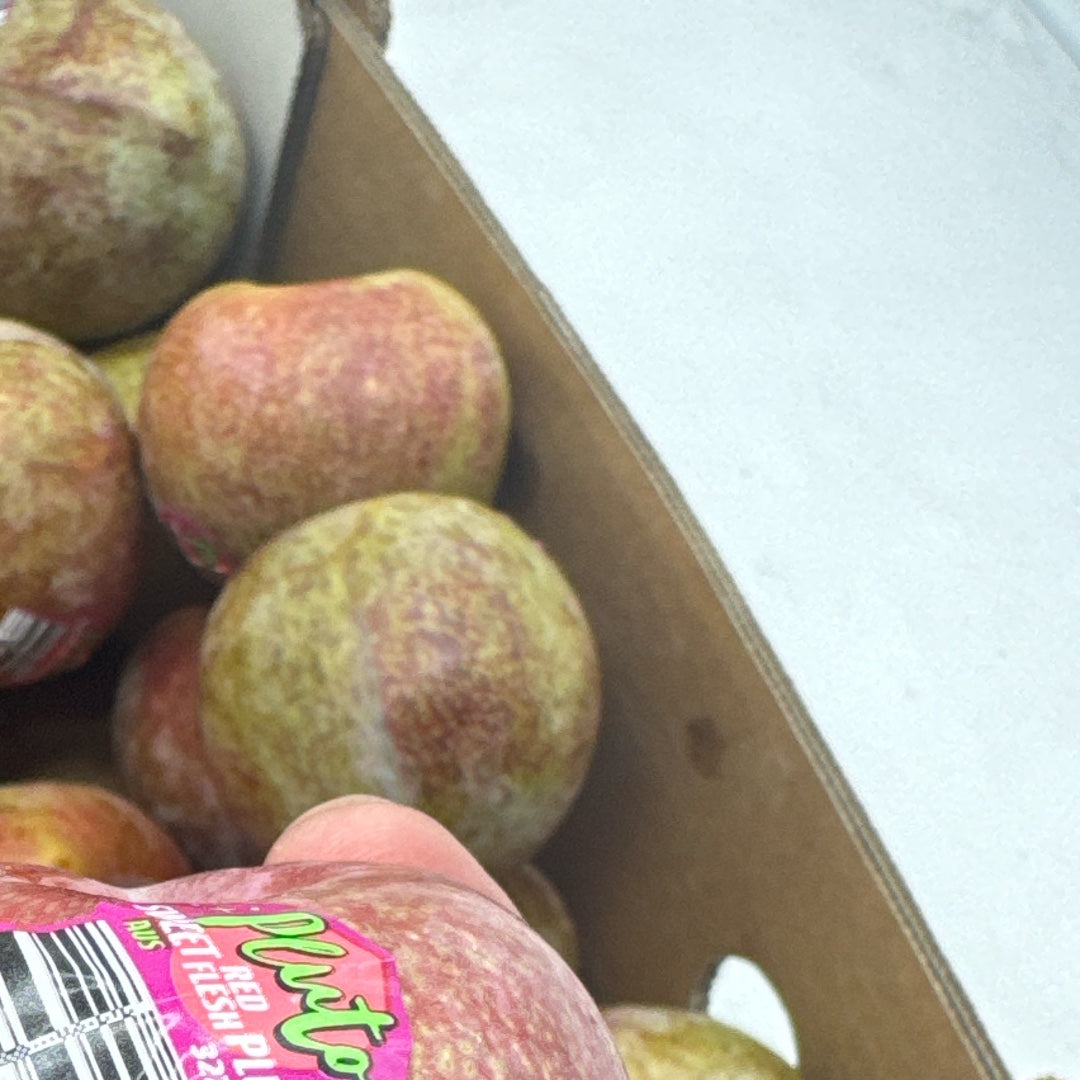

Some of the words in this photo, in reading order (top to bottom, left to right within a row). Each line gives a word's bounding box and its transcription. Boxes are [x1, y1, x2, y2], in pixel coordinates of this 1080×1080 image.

[128, 919, 167, 951] AUS
[132, 904, 223, 959] SWEET
[182, 962, 245, 1030] FLESH
[220, 965, 270, 1011] RED
